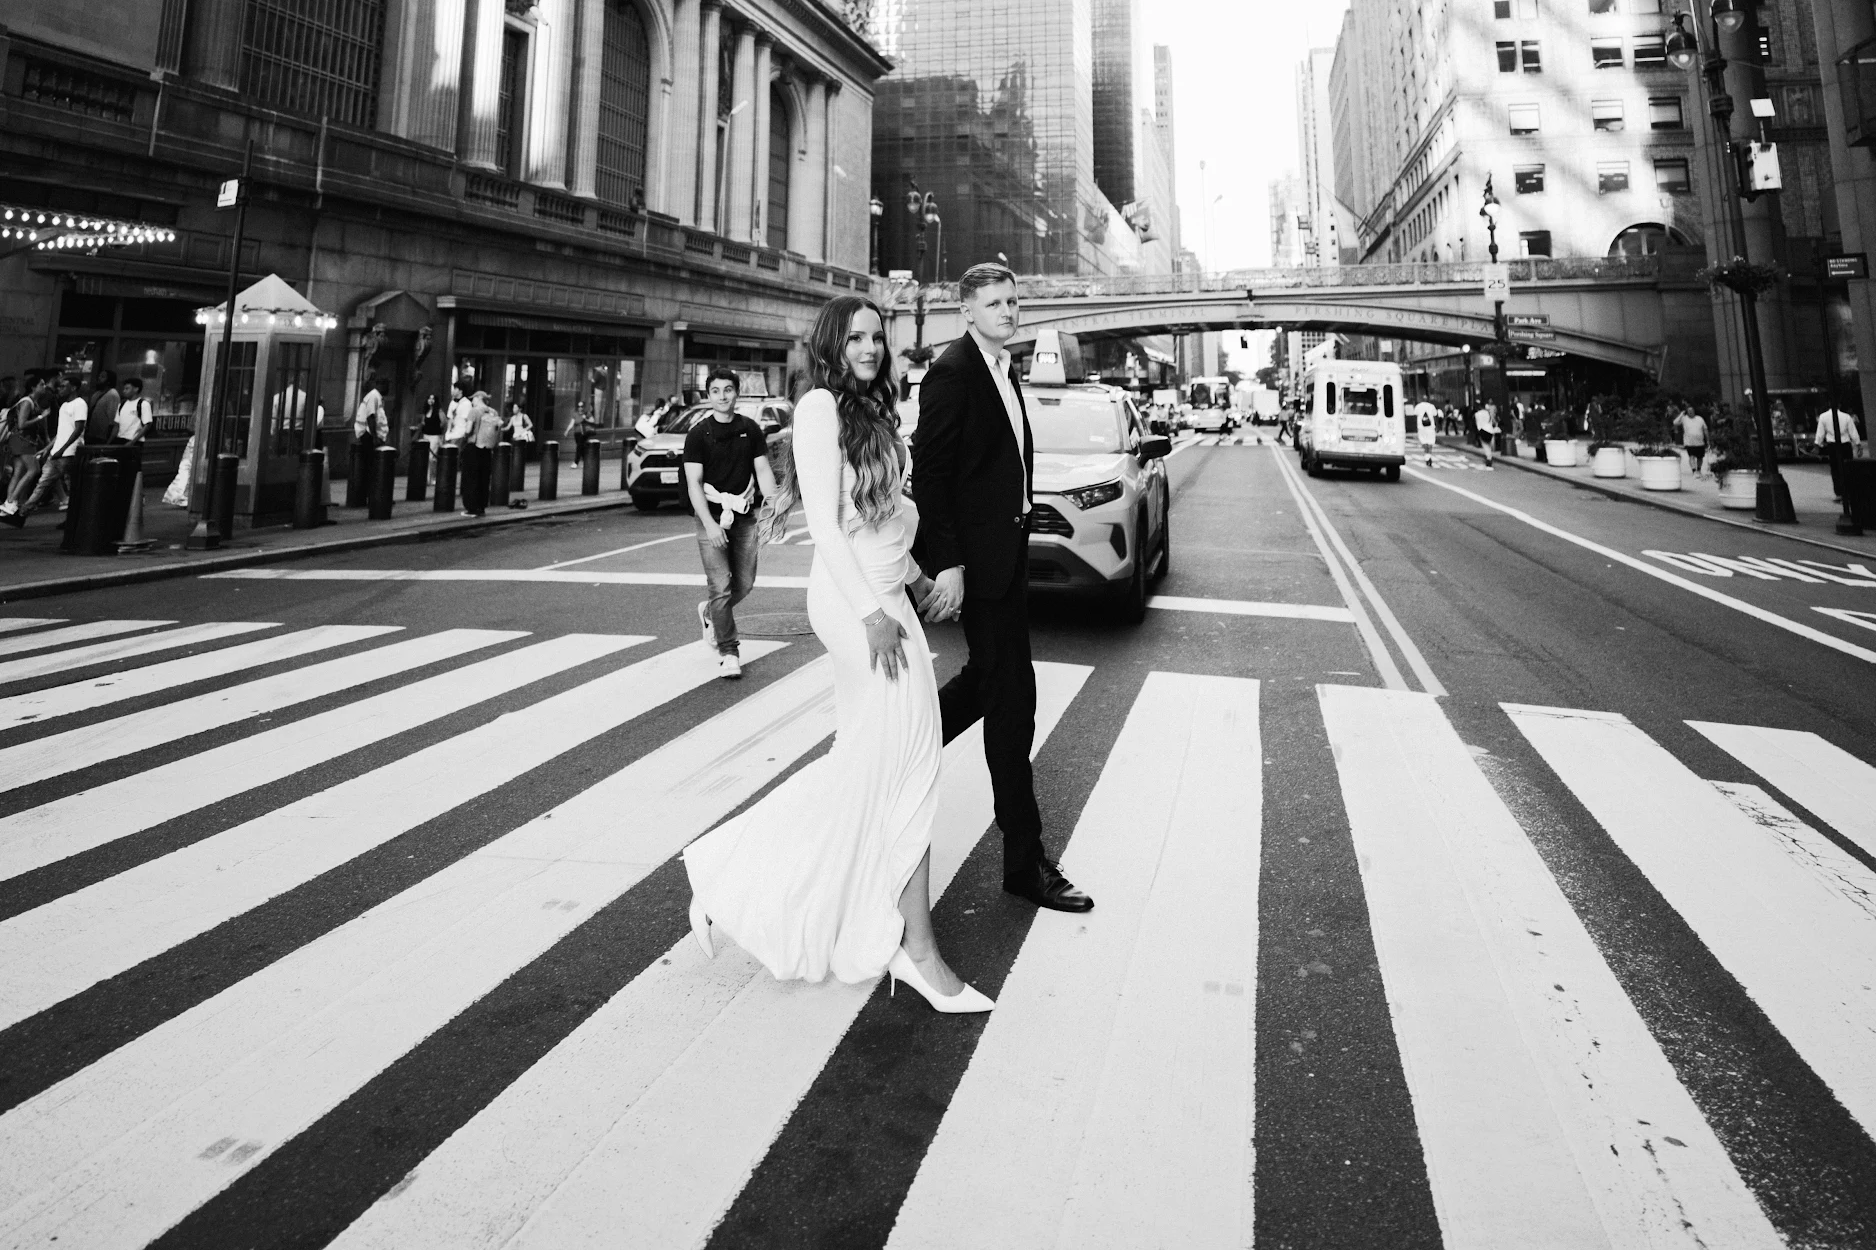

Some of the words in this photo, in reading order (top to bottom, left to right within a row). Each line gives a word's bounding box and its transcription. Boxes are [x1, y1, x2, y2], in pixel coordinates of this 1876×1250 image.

[1488, 279, 1506, 289] 25
[1129, 308, 1206, 321] TERMINAL
[1295, 306, 1375, 319] PERSHING
[1386, 312, 1449, 327] SQUARE
